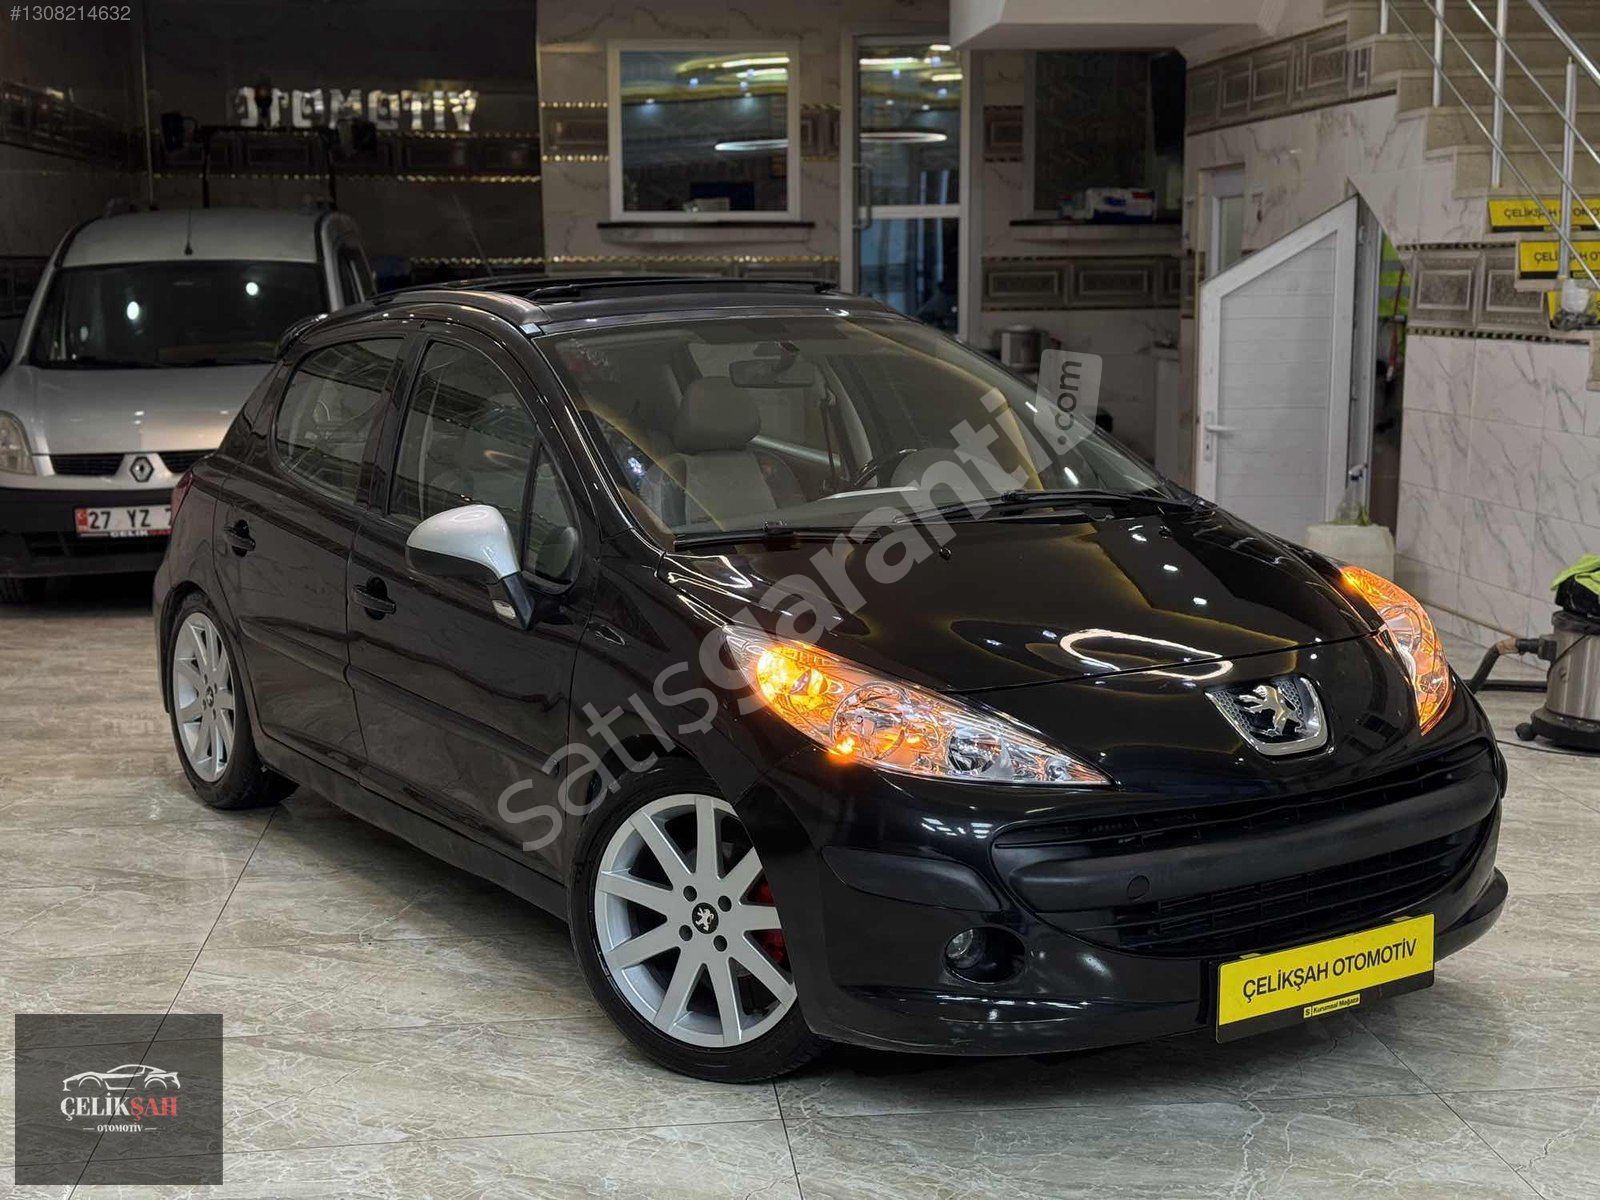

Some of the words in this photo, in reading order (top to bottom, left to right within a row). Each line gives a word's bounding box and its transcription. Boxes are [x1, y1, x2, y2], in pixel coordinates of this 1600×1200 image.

[89, 512, 111, 529] 27
[127, 509, 151, 527] YZ
[1243, 963, 1329, 1003] ÇELİKŞAH
[1332, 938, 1418, 977] OTOMOTİV
